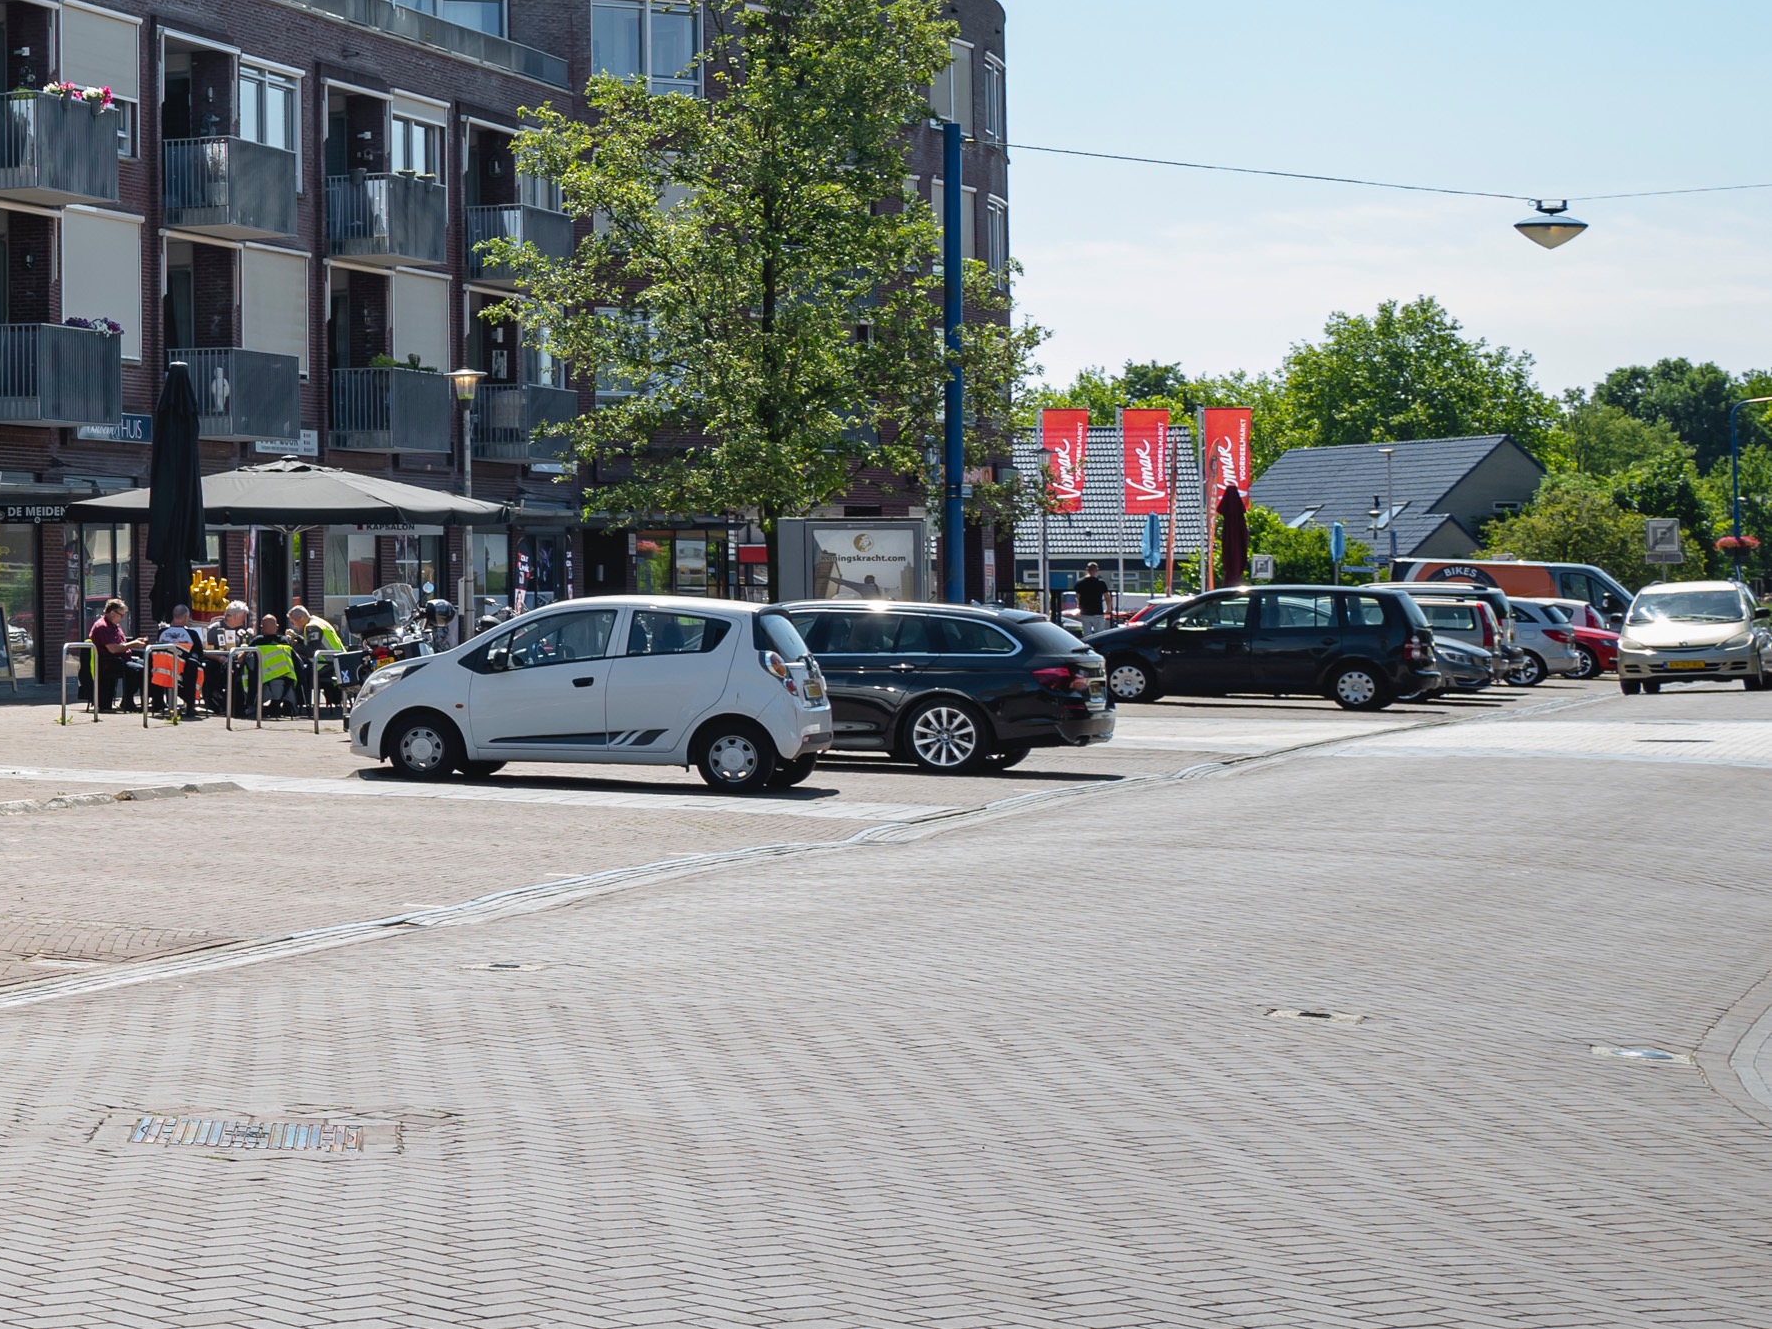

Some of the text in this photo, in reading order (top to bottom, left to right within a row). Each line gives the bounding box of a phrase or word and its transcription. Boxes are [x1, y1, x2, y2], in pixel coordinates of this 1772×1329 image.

[1052, 438, 1081, 499] Vomar
[1125, 438, 1166, 501] Vomar
[1157, 421, 1165, 482] VOORDEELMARKT
[1239, 418, 1247, 481] VOORDEELMARKT
[7, 506, 66, 517] DE MEIDEN
[1443, 566, 1478, 578] BIKES
